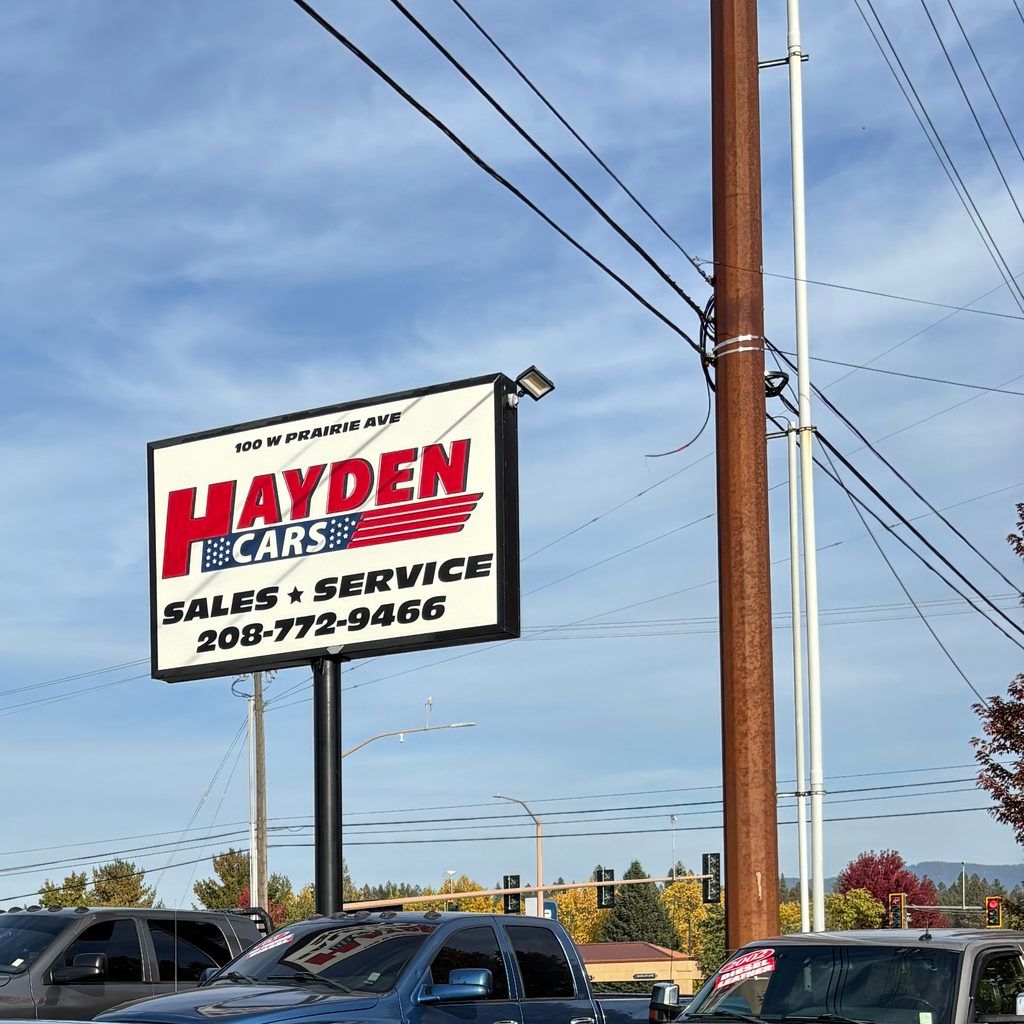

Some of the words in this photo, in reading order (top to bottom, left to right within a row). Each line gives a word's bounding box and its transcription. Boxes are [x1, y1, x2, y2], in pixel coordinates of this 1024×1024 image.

[234, 438, 262, 453] 100
[266, 434, 281, 448] W
[285, 420, 361, 444] PRAIRIE
[363, 412, 401, 429] AVE
[162, 438, 471, 579] HAYDEN
[232, 520, 327, 564] CARS
[162, 586, 278, 625] SALES
[313, 553, 494, 602] SERVICE
[196, 596, 447, 653] 208-772-9466
